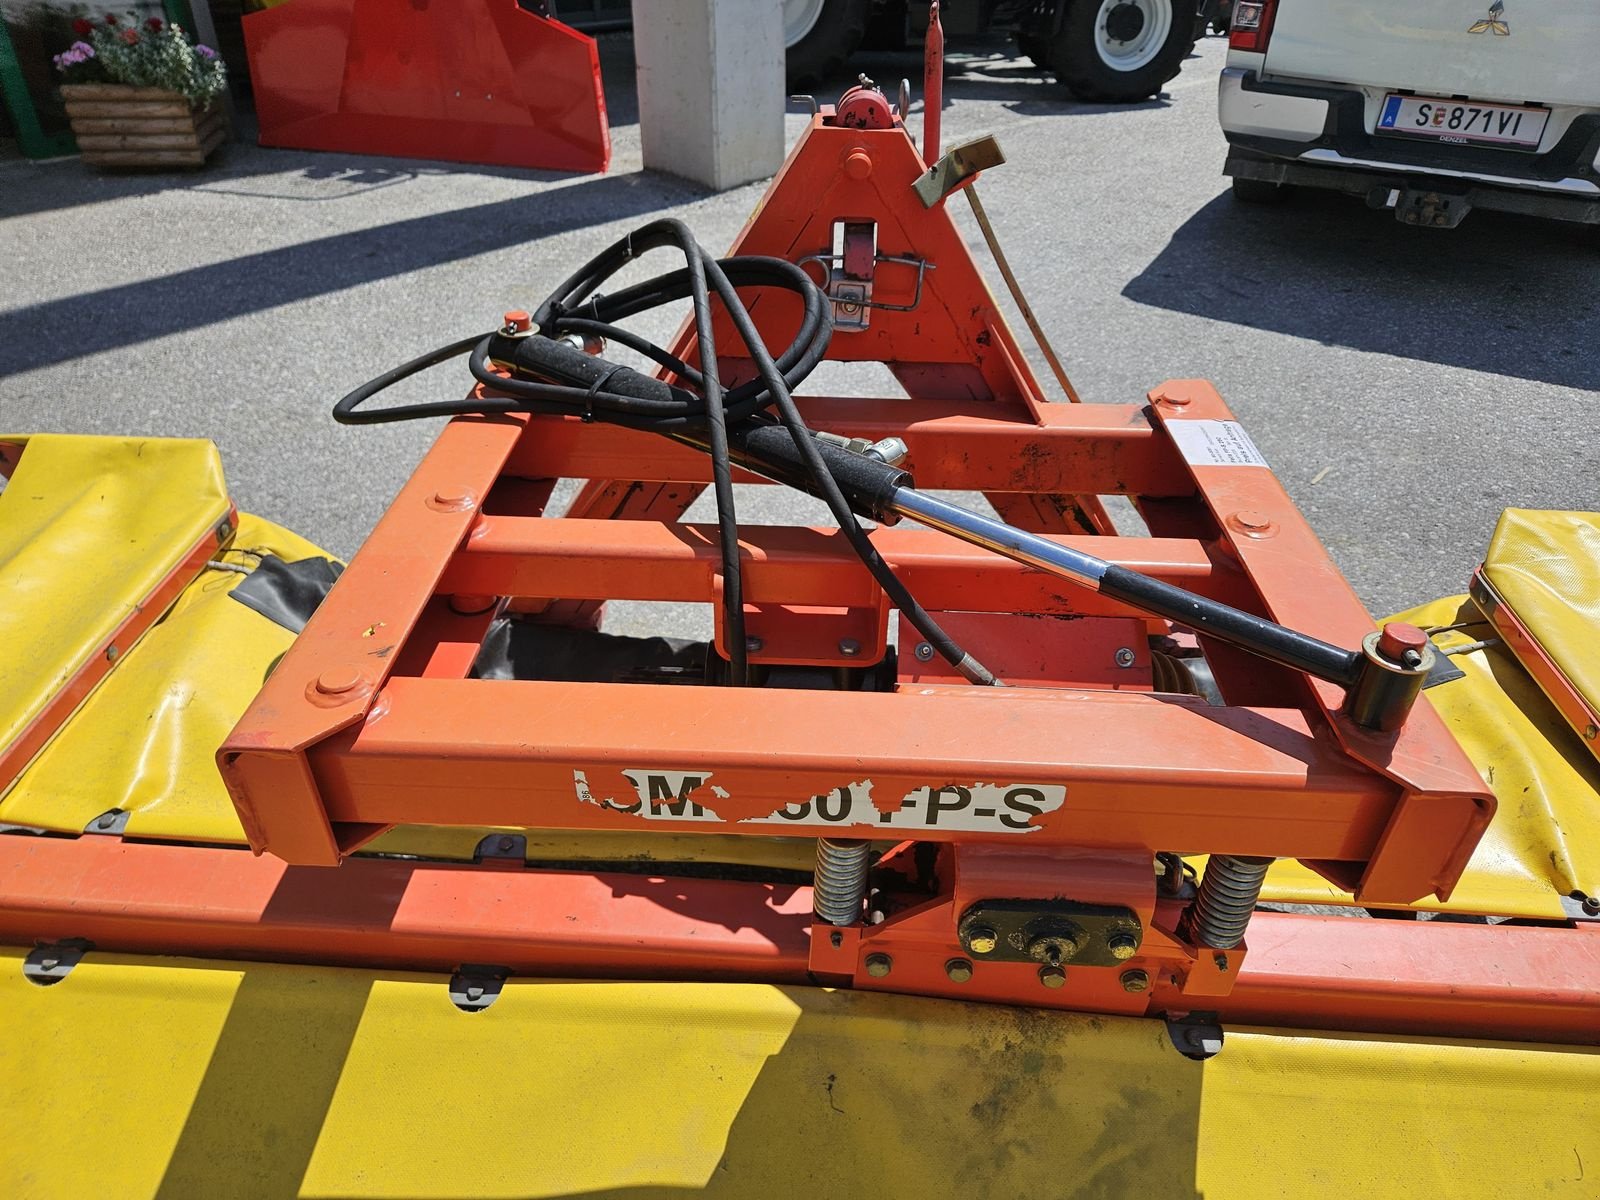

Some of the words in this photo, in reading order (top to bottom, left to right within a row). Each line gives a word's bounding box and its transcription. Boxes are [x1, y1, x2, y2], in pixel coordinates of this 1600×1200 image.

[1384, 115, 1393, 123] A
[1415, 104, 1431, 126] S
[1439, 135, 1468, 143] DENZEL
